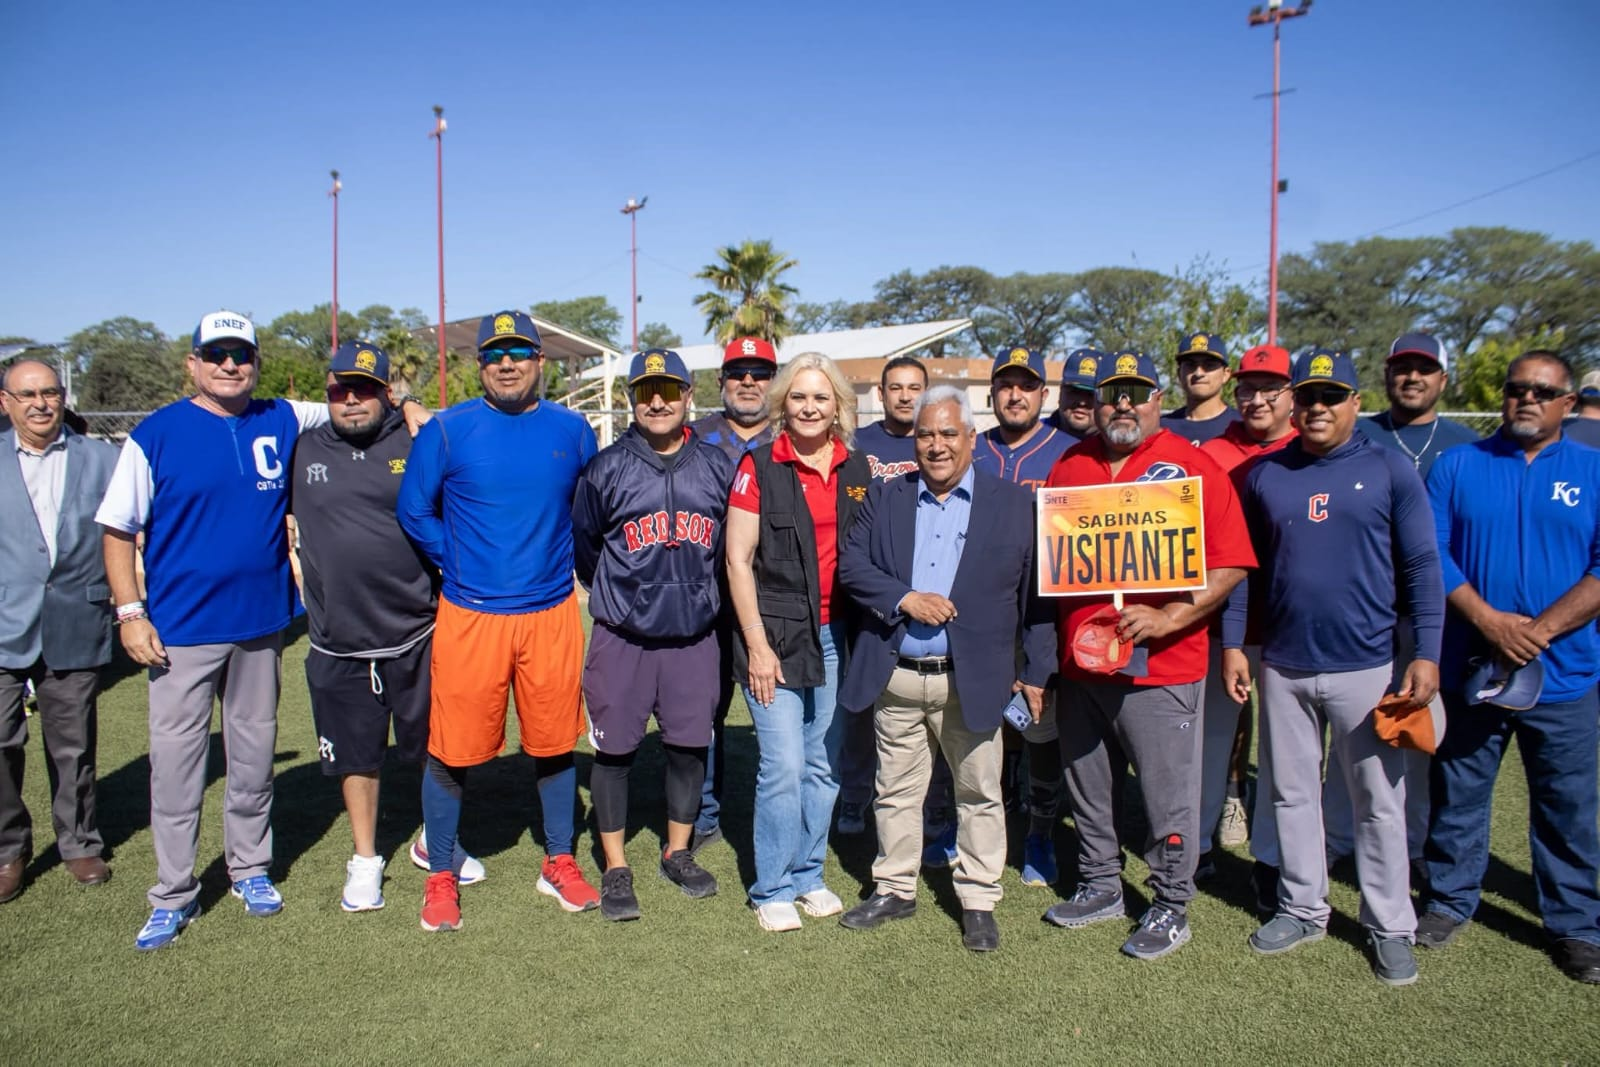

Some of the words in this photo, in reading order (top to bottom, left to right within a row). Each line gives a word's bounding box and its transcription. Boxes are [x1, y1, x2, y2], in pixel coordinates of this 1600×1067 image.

[214, 318, 246, 331] ENEF
[252, 435, 284, 480] C
[732, 471, 751, 495] M
[1182, 484, 1190, 495] 5
[1551, 481, 1581, 507] KC
[1078, 510, 1168, 529] SABINAS
[1308, 492, 1330, 523] C
[623, 510, 670, 553] RED
[675, 510, 714, 549] SOX
[1046, 526, 1198, 585] VISITANTE
